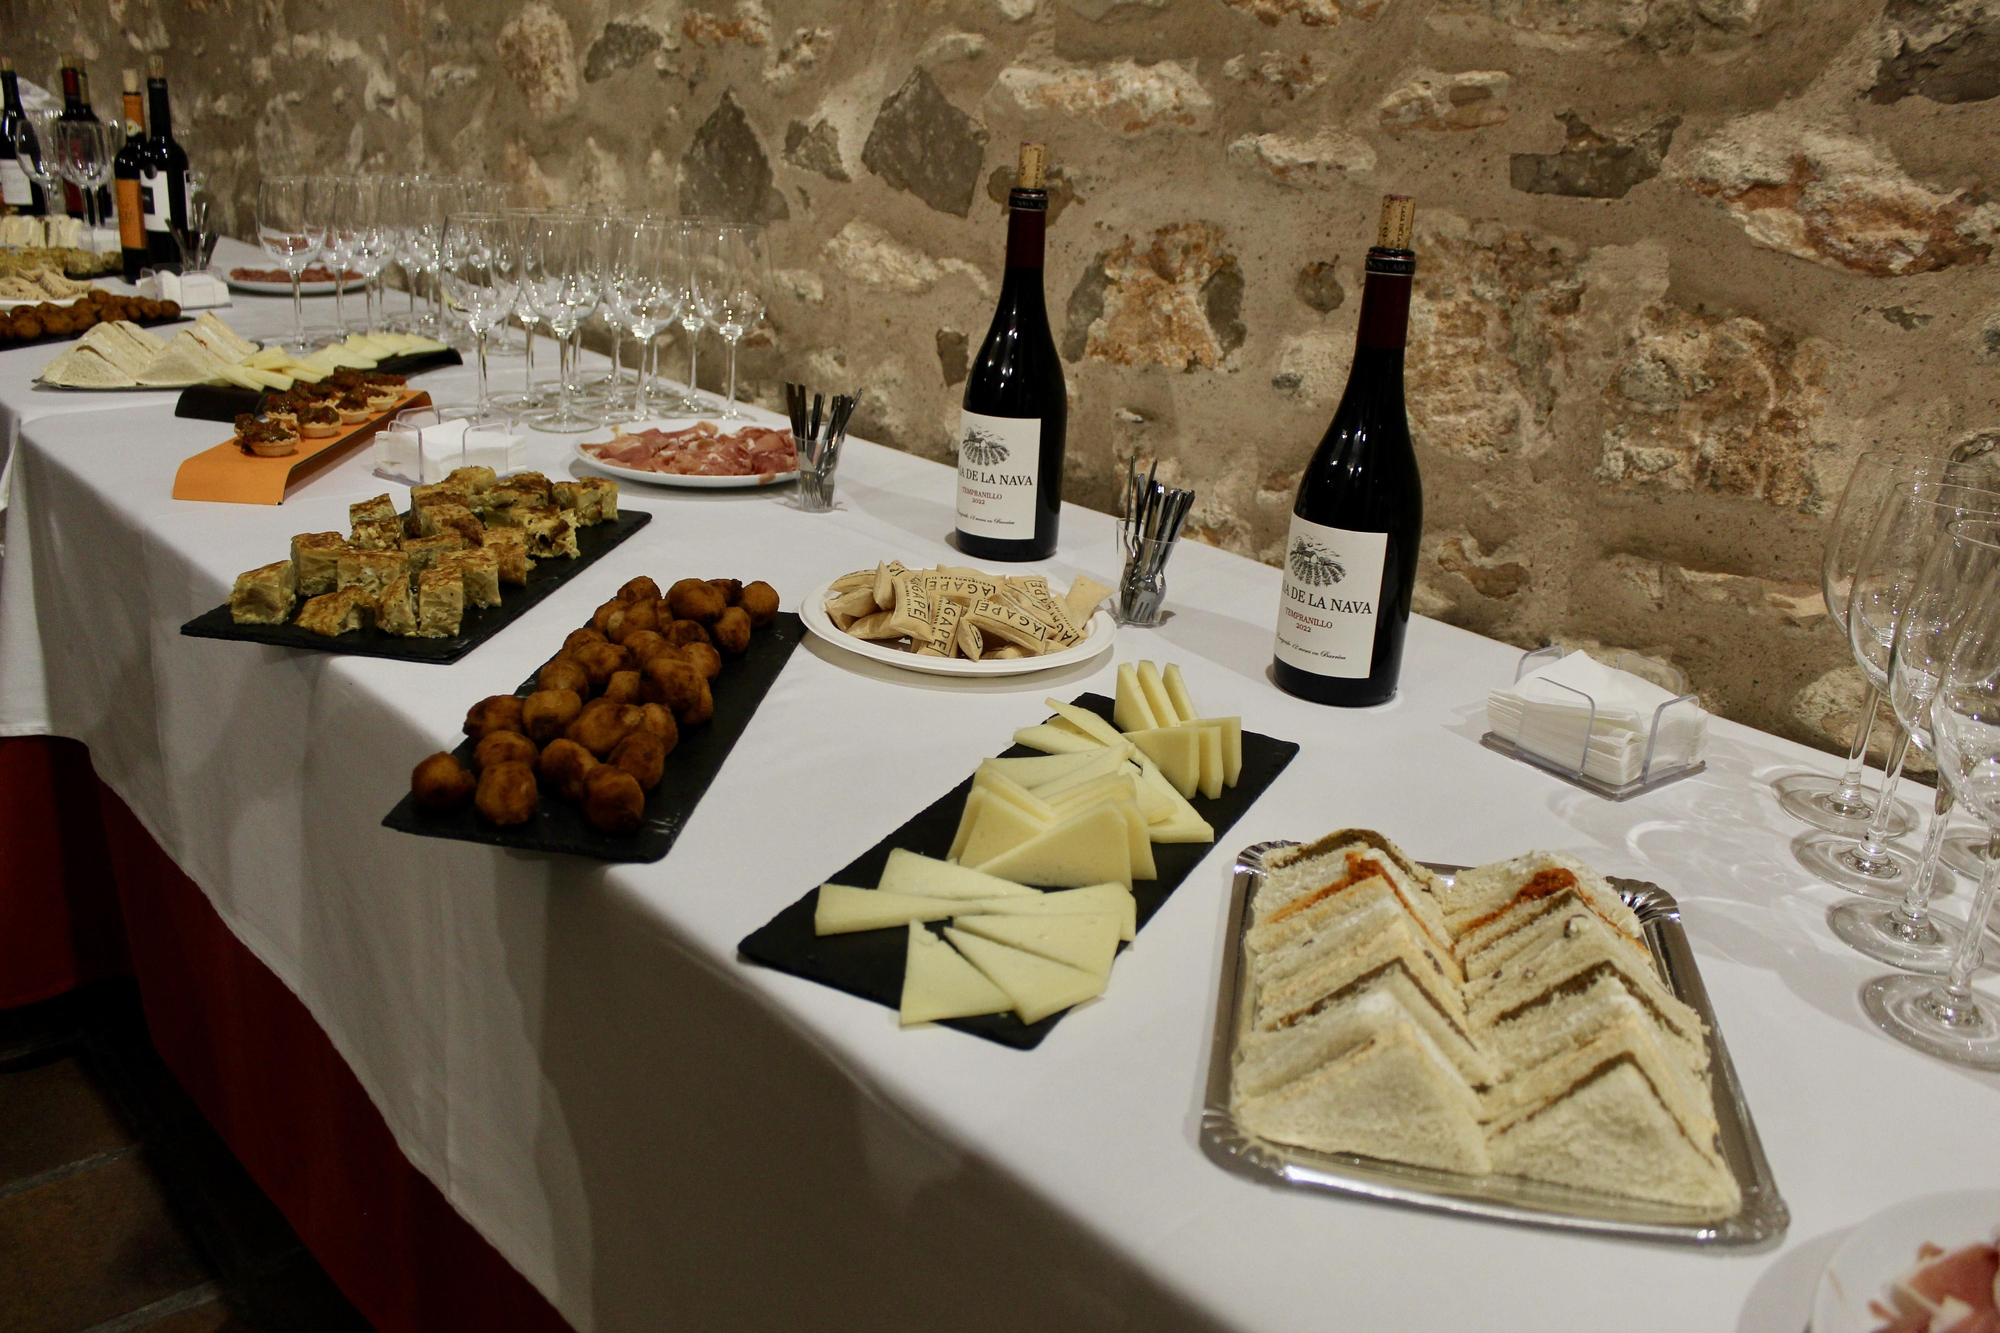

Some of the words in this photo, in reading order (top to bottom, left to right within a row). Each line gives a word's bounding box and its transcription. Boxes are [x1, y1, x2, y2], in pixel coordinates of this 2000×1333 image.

[966, 468, 978, 481] DE
[981, 472, 996, 484] LA
[999, 474, 1033, 486] NAVA
[962, 486, 1003, 500] TEMPRANILLO
[1291, 586, 1306, 604] DE
[1308, 593, 1327, 610] LA
[1330, 598, 1372, 615] NAVA
[1285, 607, 1333, 629] TEMPRANILLO
[1296, 622, 1312, 633] 2022
